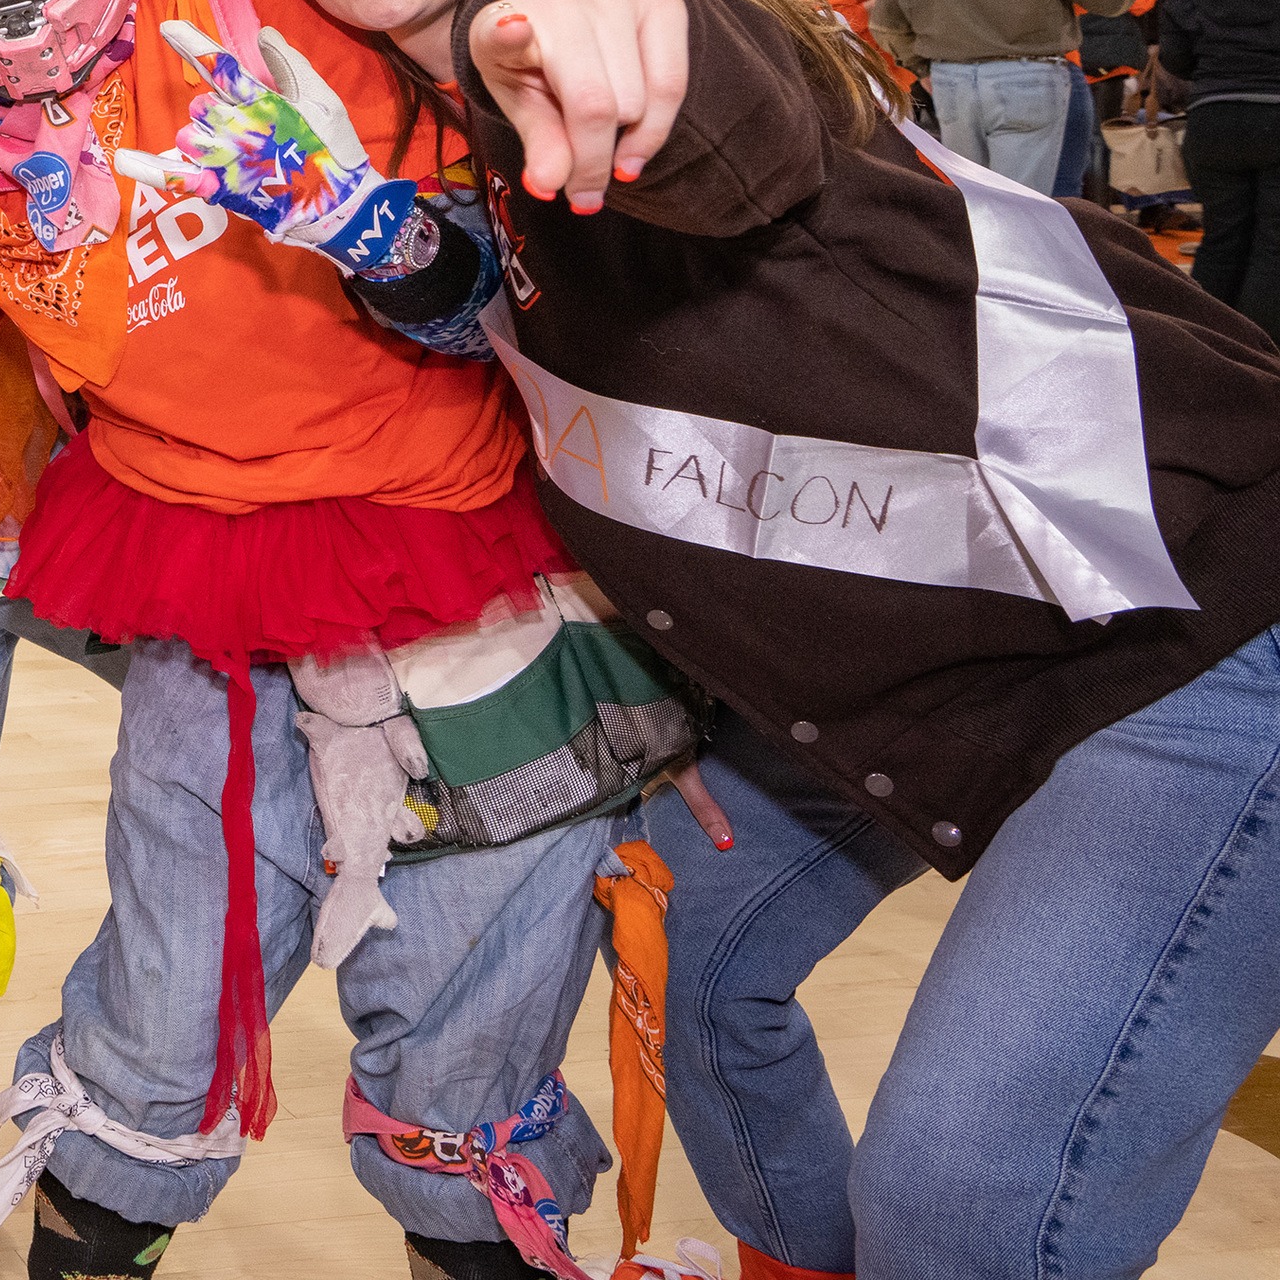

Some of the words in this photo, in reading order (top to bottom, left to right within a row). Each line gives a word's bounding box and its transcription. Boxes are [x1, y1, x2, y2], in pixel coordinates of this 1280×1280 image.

[126, 197, 228, 284] ED
[126, 276, 186, 327] oca-Cola
[644, 447, 894, 536] FALCON
